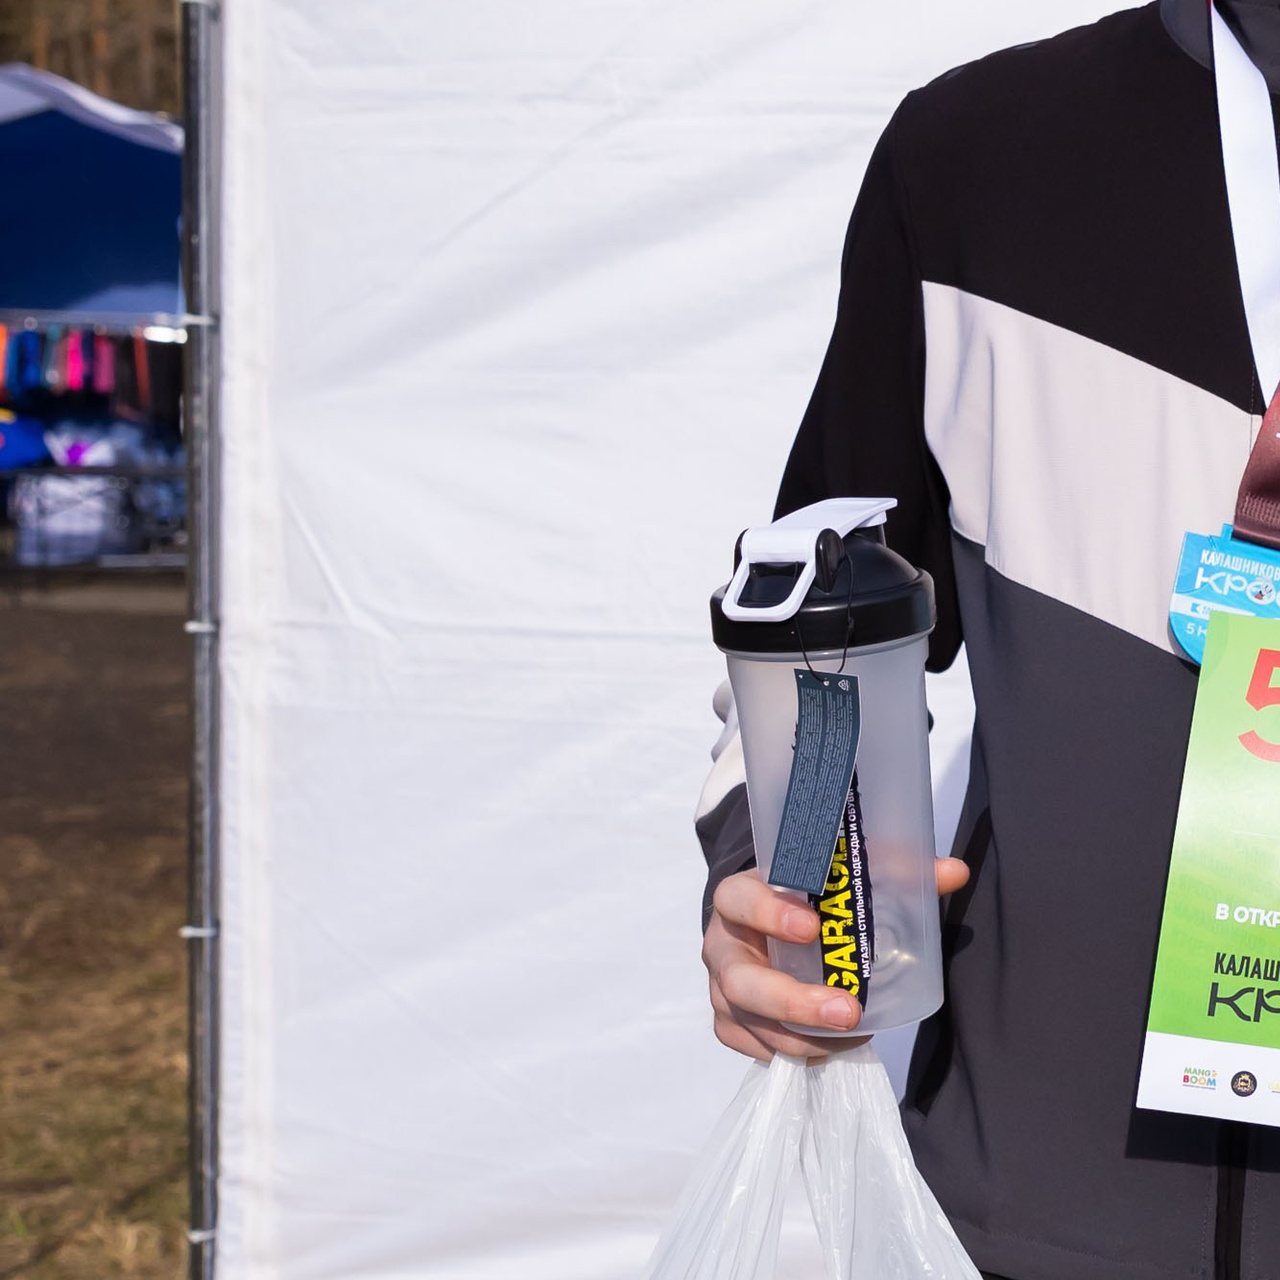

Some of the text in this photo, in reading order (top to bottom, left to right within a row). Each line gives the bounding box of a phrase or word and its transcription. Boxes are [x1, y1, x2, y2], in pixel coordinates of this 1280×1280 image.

[1201, 549, 1280, 582] КАЛАШНИКОВ
[844, 788, 857, 821] ОБУВИ
[848, 831, 863, 876] ОДЕЖДЫ
[851, 877, 867, 931] СТИЛЬНОЙ
[1215, 903, 1229, 920] В
[859, 931, 872, 978] МАГАЗИН
[1183, 1074, 1217, 1087] BOOM
